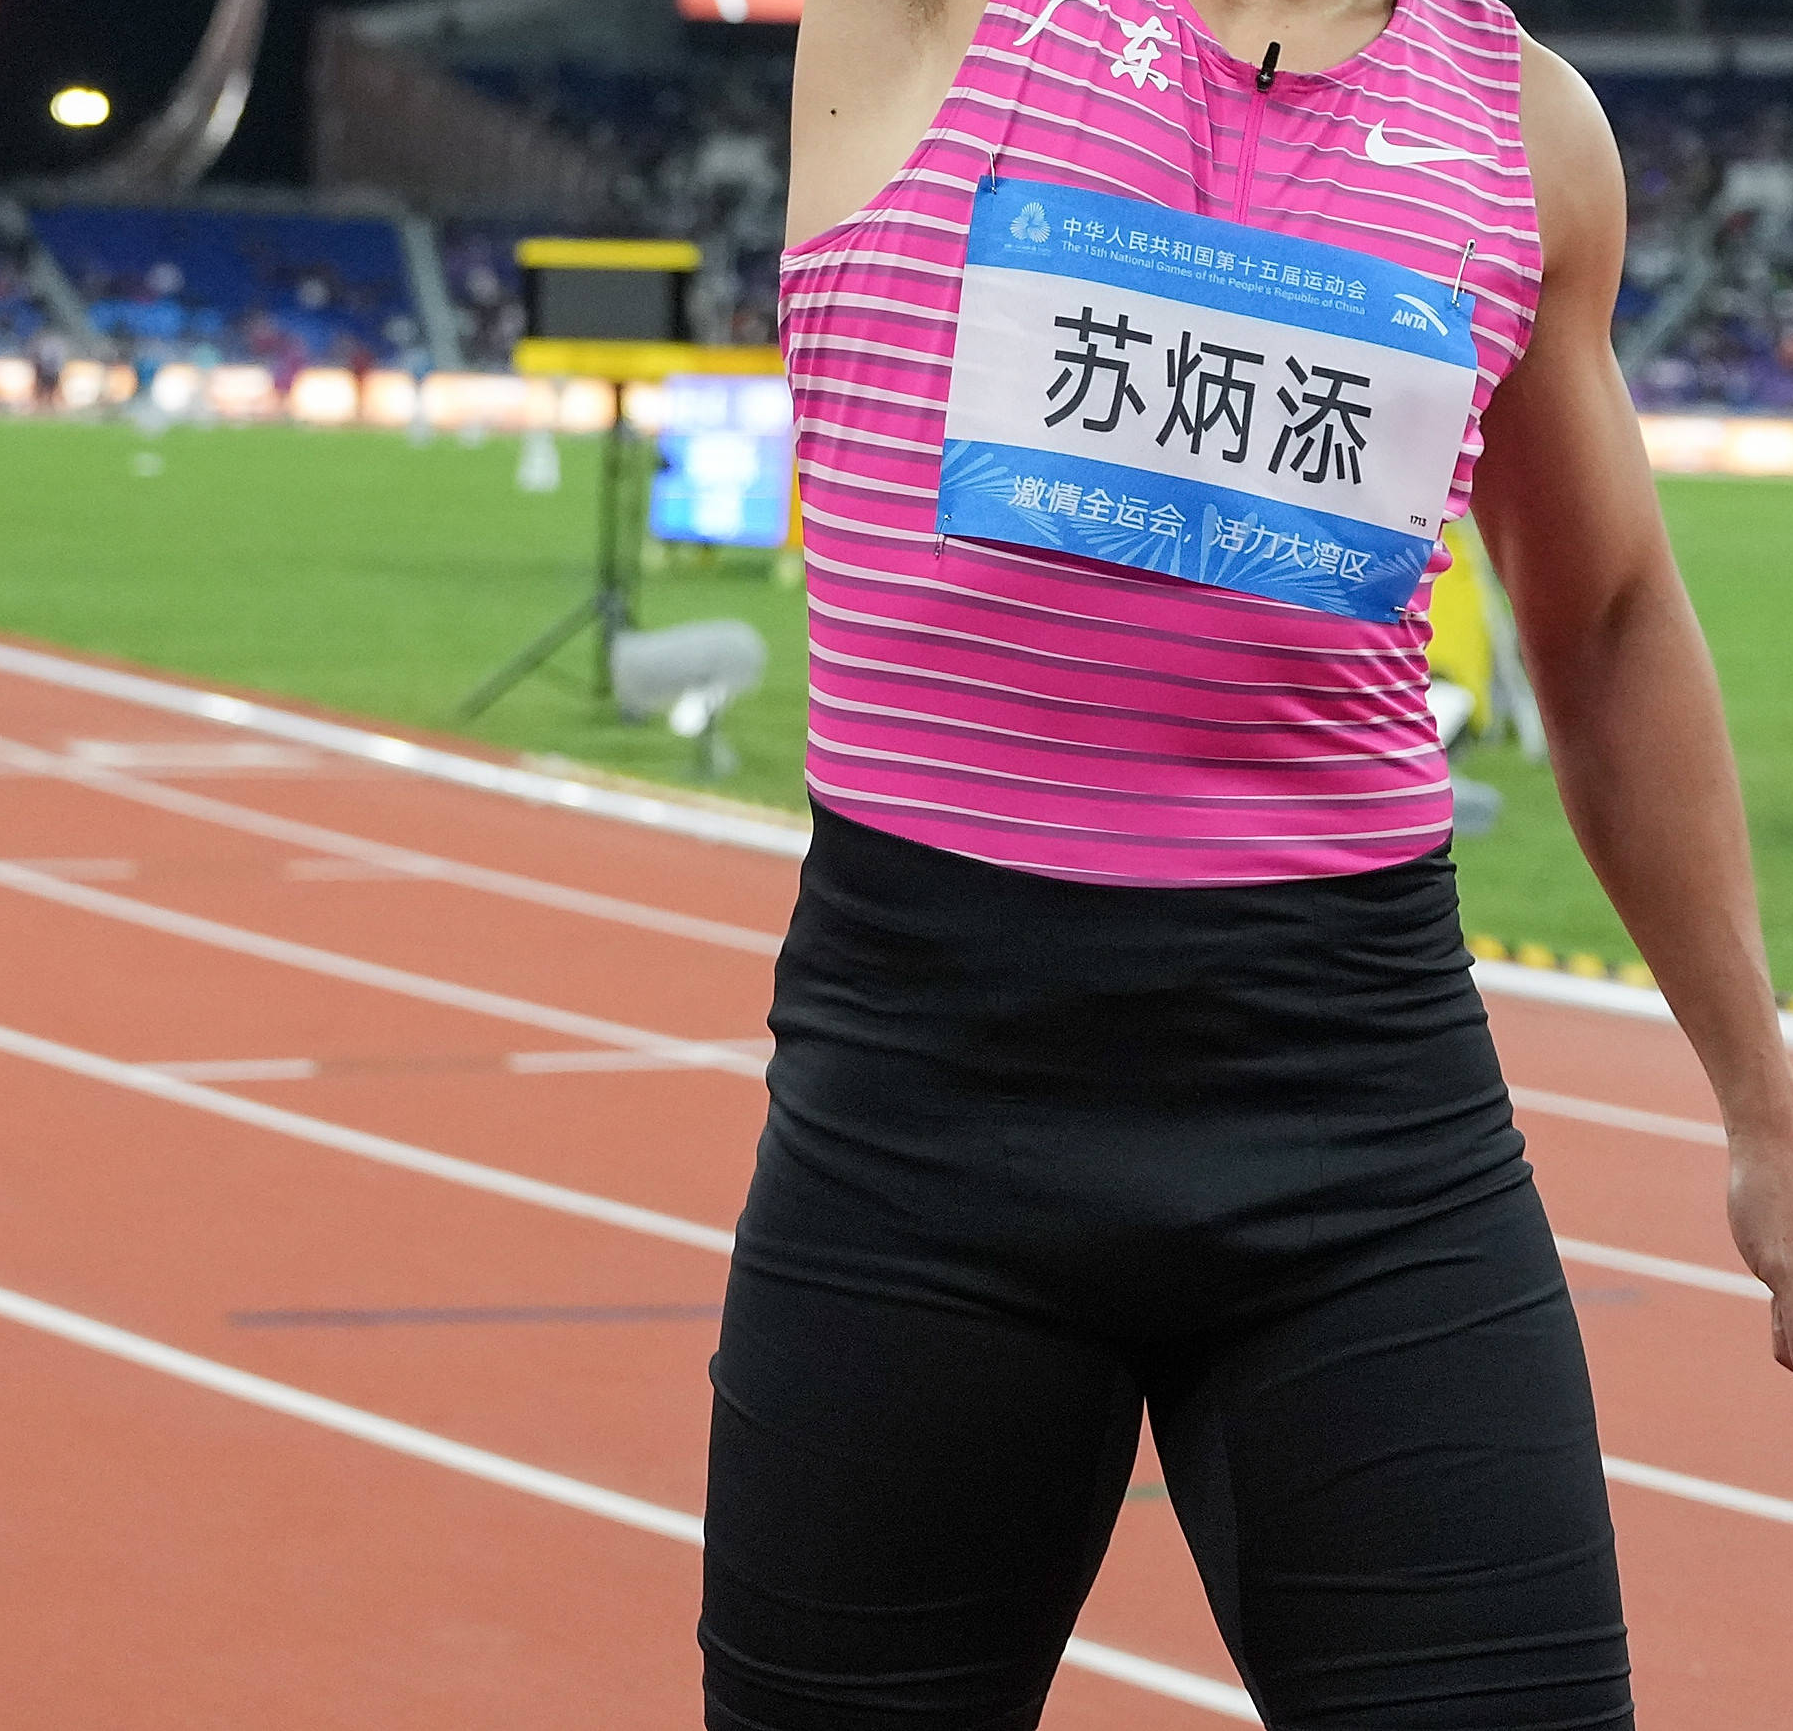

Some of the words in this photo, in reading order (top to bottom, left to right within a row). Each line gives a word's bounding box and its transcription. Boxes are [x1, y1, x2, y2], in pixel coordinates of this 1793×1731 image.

[1062, 217, 1367, 301] 中华人民共和国第十五届运动会
[1062, 240, 1081, 253] The
[1085, 244, 1107, 259] 15th
[1110, 250, 1155, 270] National
[1156, 261, 1193, 278] Games
[1195, 270, 1207, 280] of
[1208, 273, 1226, 286] the
[1228, 277, 1272, 295] People's
[1274, 286, 1320, 306] Republic
[1321, 299, 1334, 308] of
[1335, 300, 1366, 316] China
[1391, 309, 1427, 331] ANTA
[1044, 306, 1373, 485] 苏炳添
[1410, 514, 1427, 527] 1713
